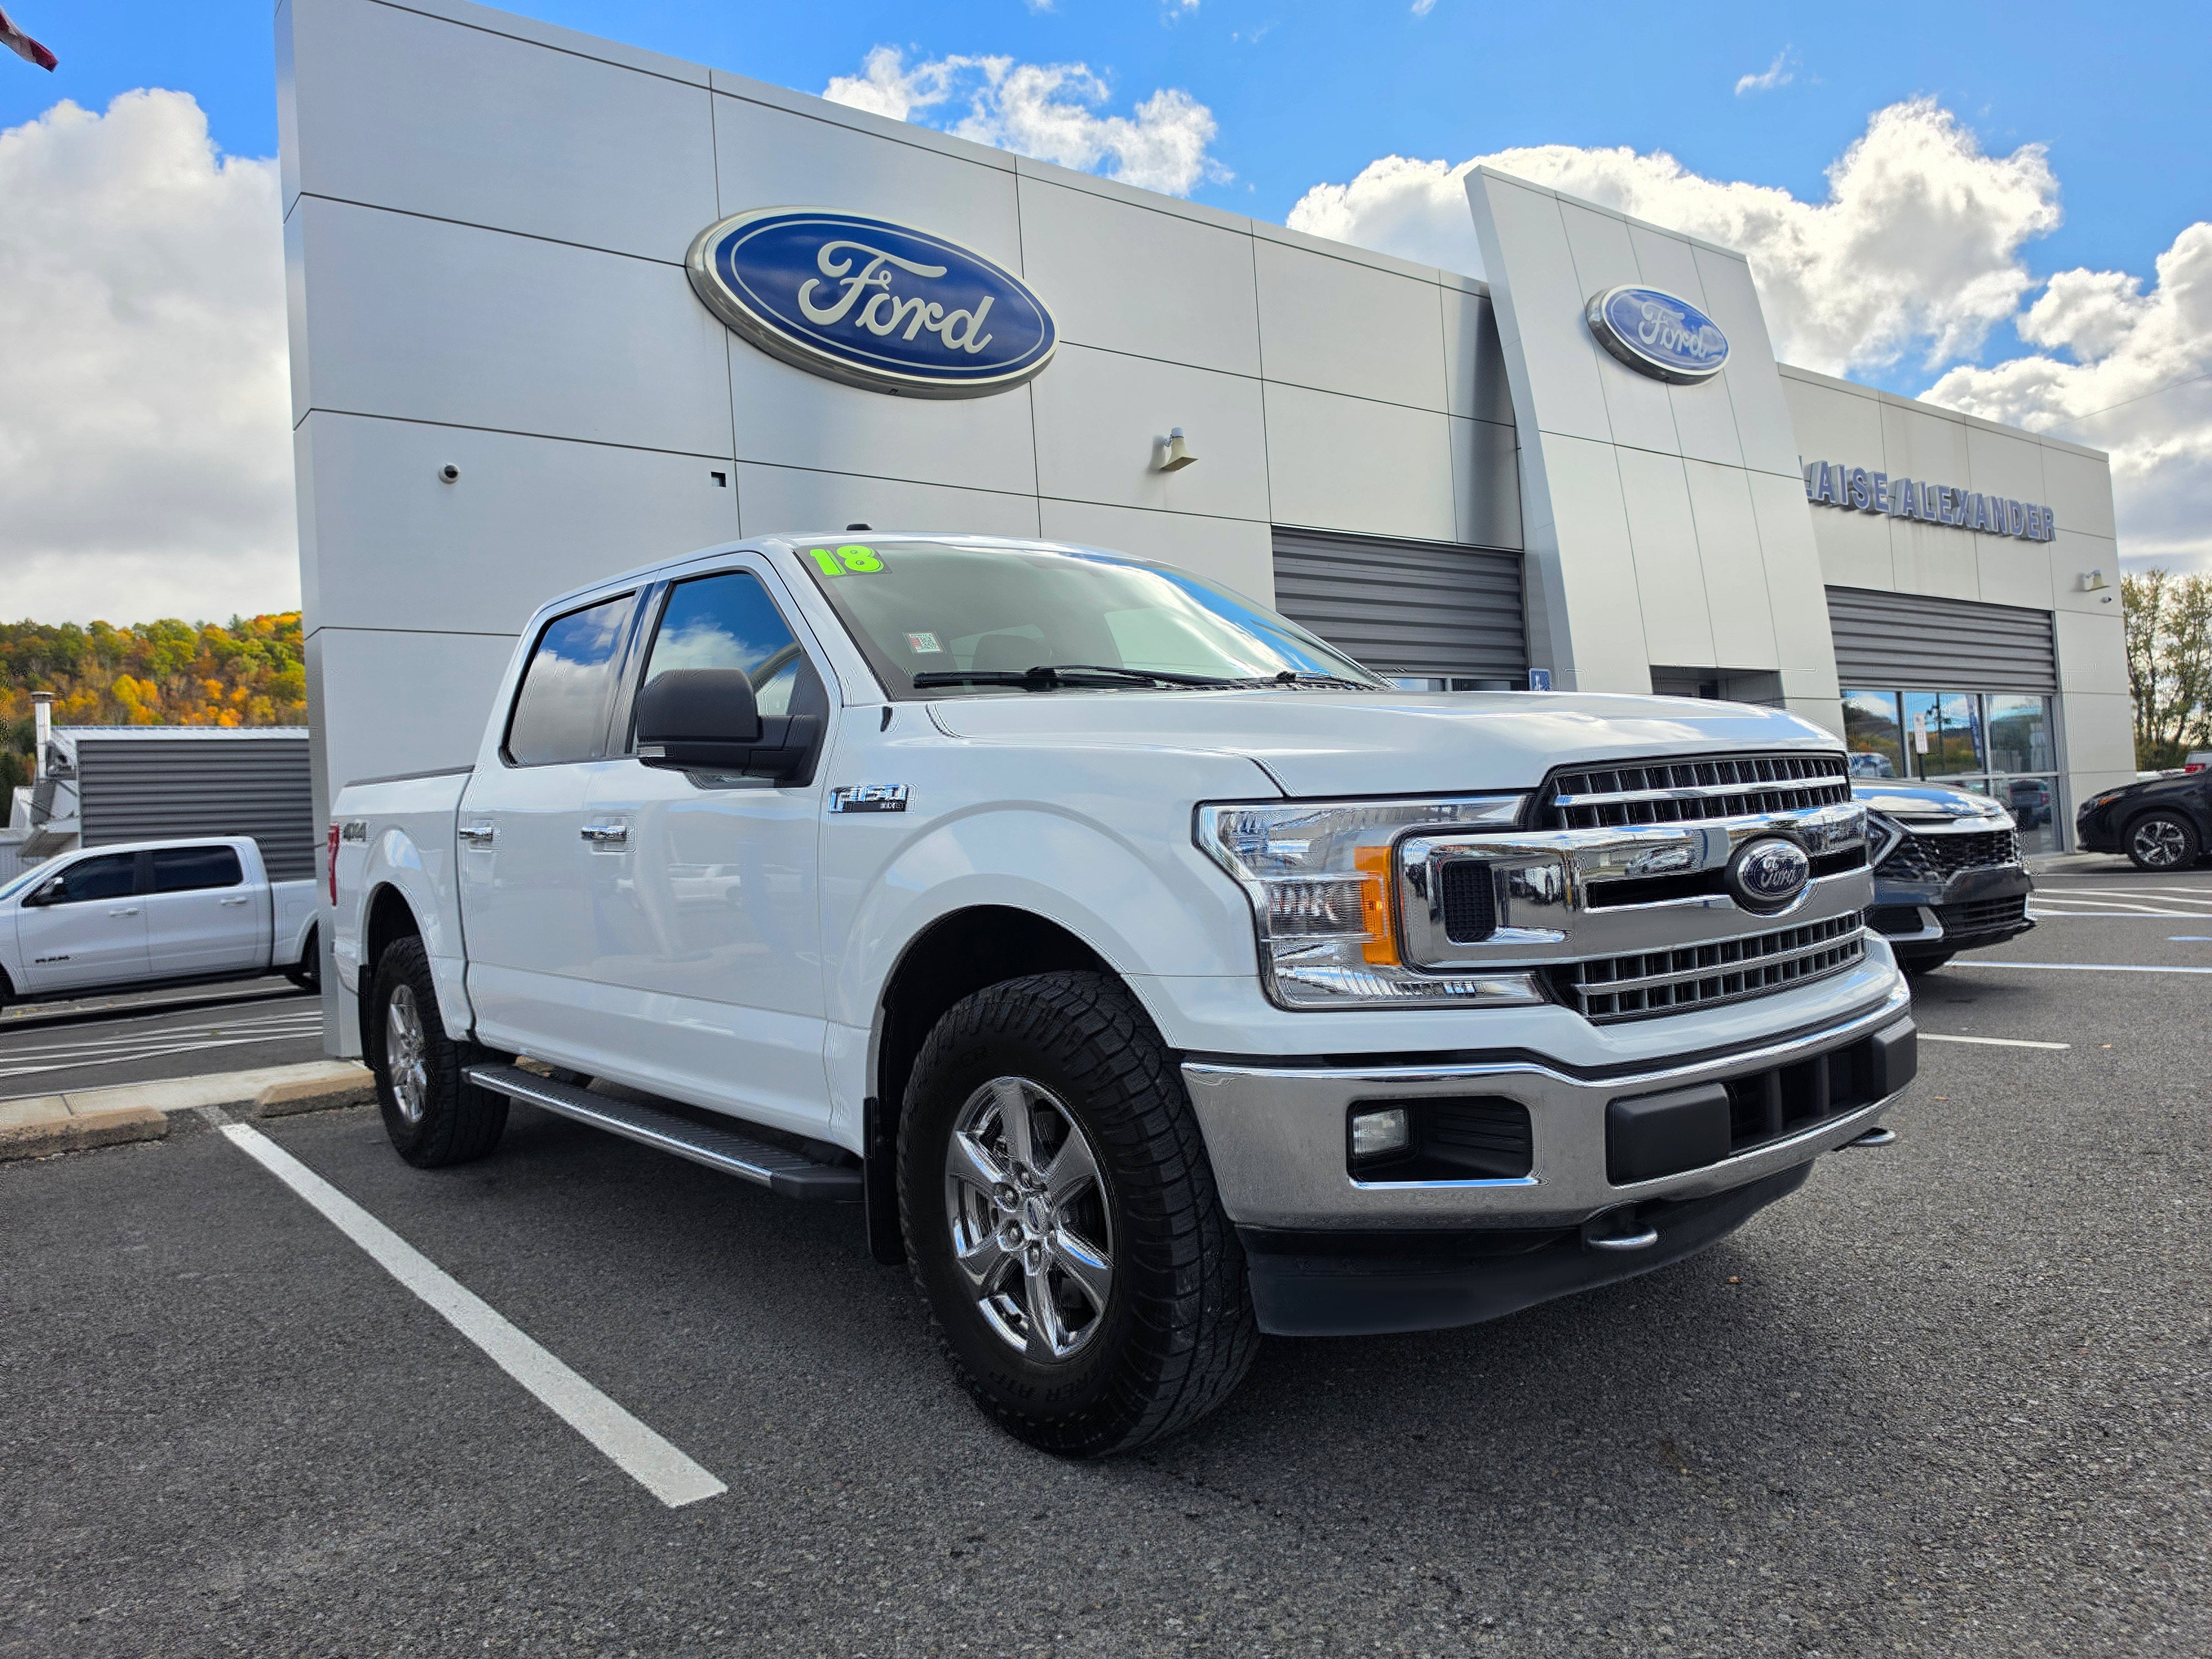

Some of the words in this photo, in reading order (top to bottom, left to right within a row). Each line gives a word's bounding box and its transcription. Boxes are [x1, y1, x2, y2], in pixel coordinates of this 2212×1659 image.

[798, 241, 995, 354] Ford
[1637, 301, 1708, 358] Ford
[1899, 477, 2057, 542] ALEXANDER
[810, 545, 885, 576] 18
[1761, 855, 1808, 888] Ford
